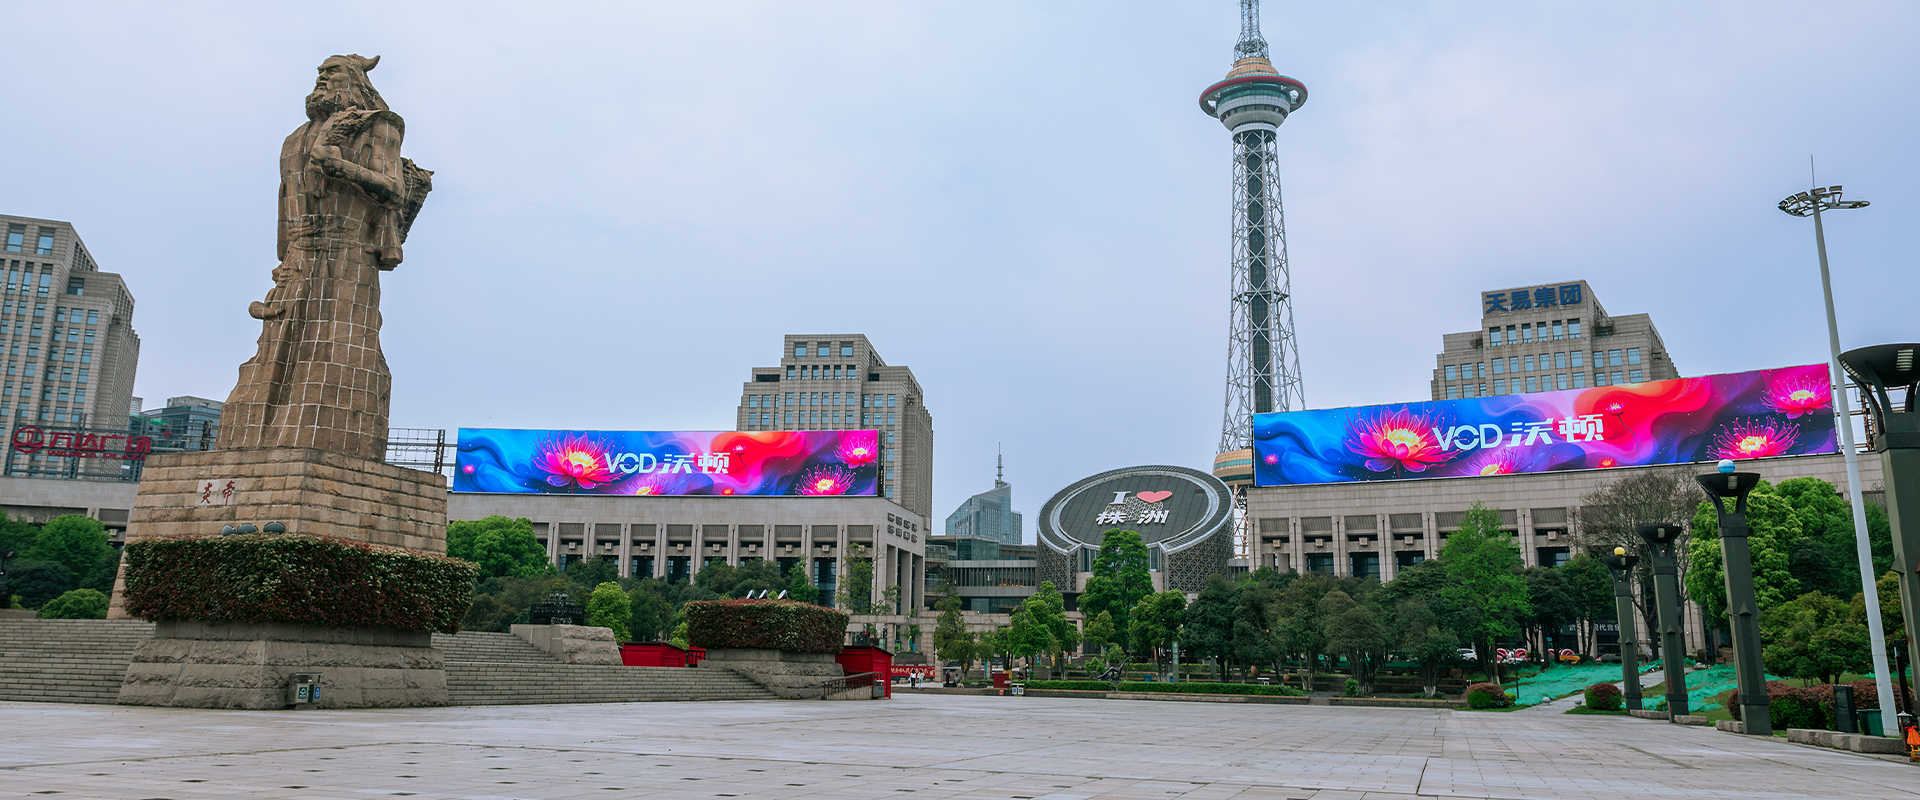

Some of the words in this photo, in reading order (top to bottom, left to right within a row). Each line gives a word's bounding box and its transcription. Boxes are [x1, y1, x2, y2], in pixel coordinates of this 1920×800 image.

[1485, 284, 1582, 314] 天易集团
[1506, 413, 1605, 447] 沃顿
[48, 431, 152, 453] 万达广场
[47, 449, 98, 459] WANDA
[102, 452, 147, 461] PLAZA
[658, 452, 731, 474] 沃顿
[201, 480, 235, 506] 炎帝
[1109, 490, 1131, 505] I
[1096, 509, 1169, 525] 株洲
